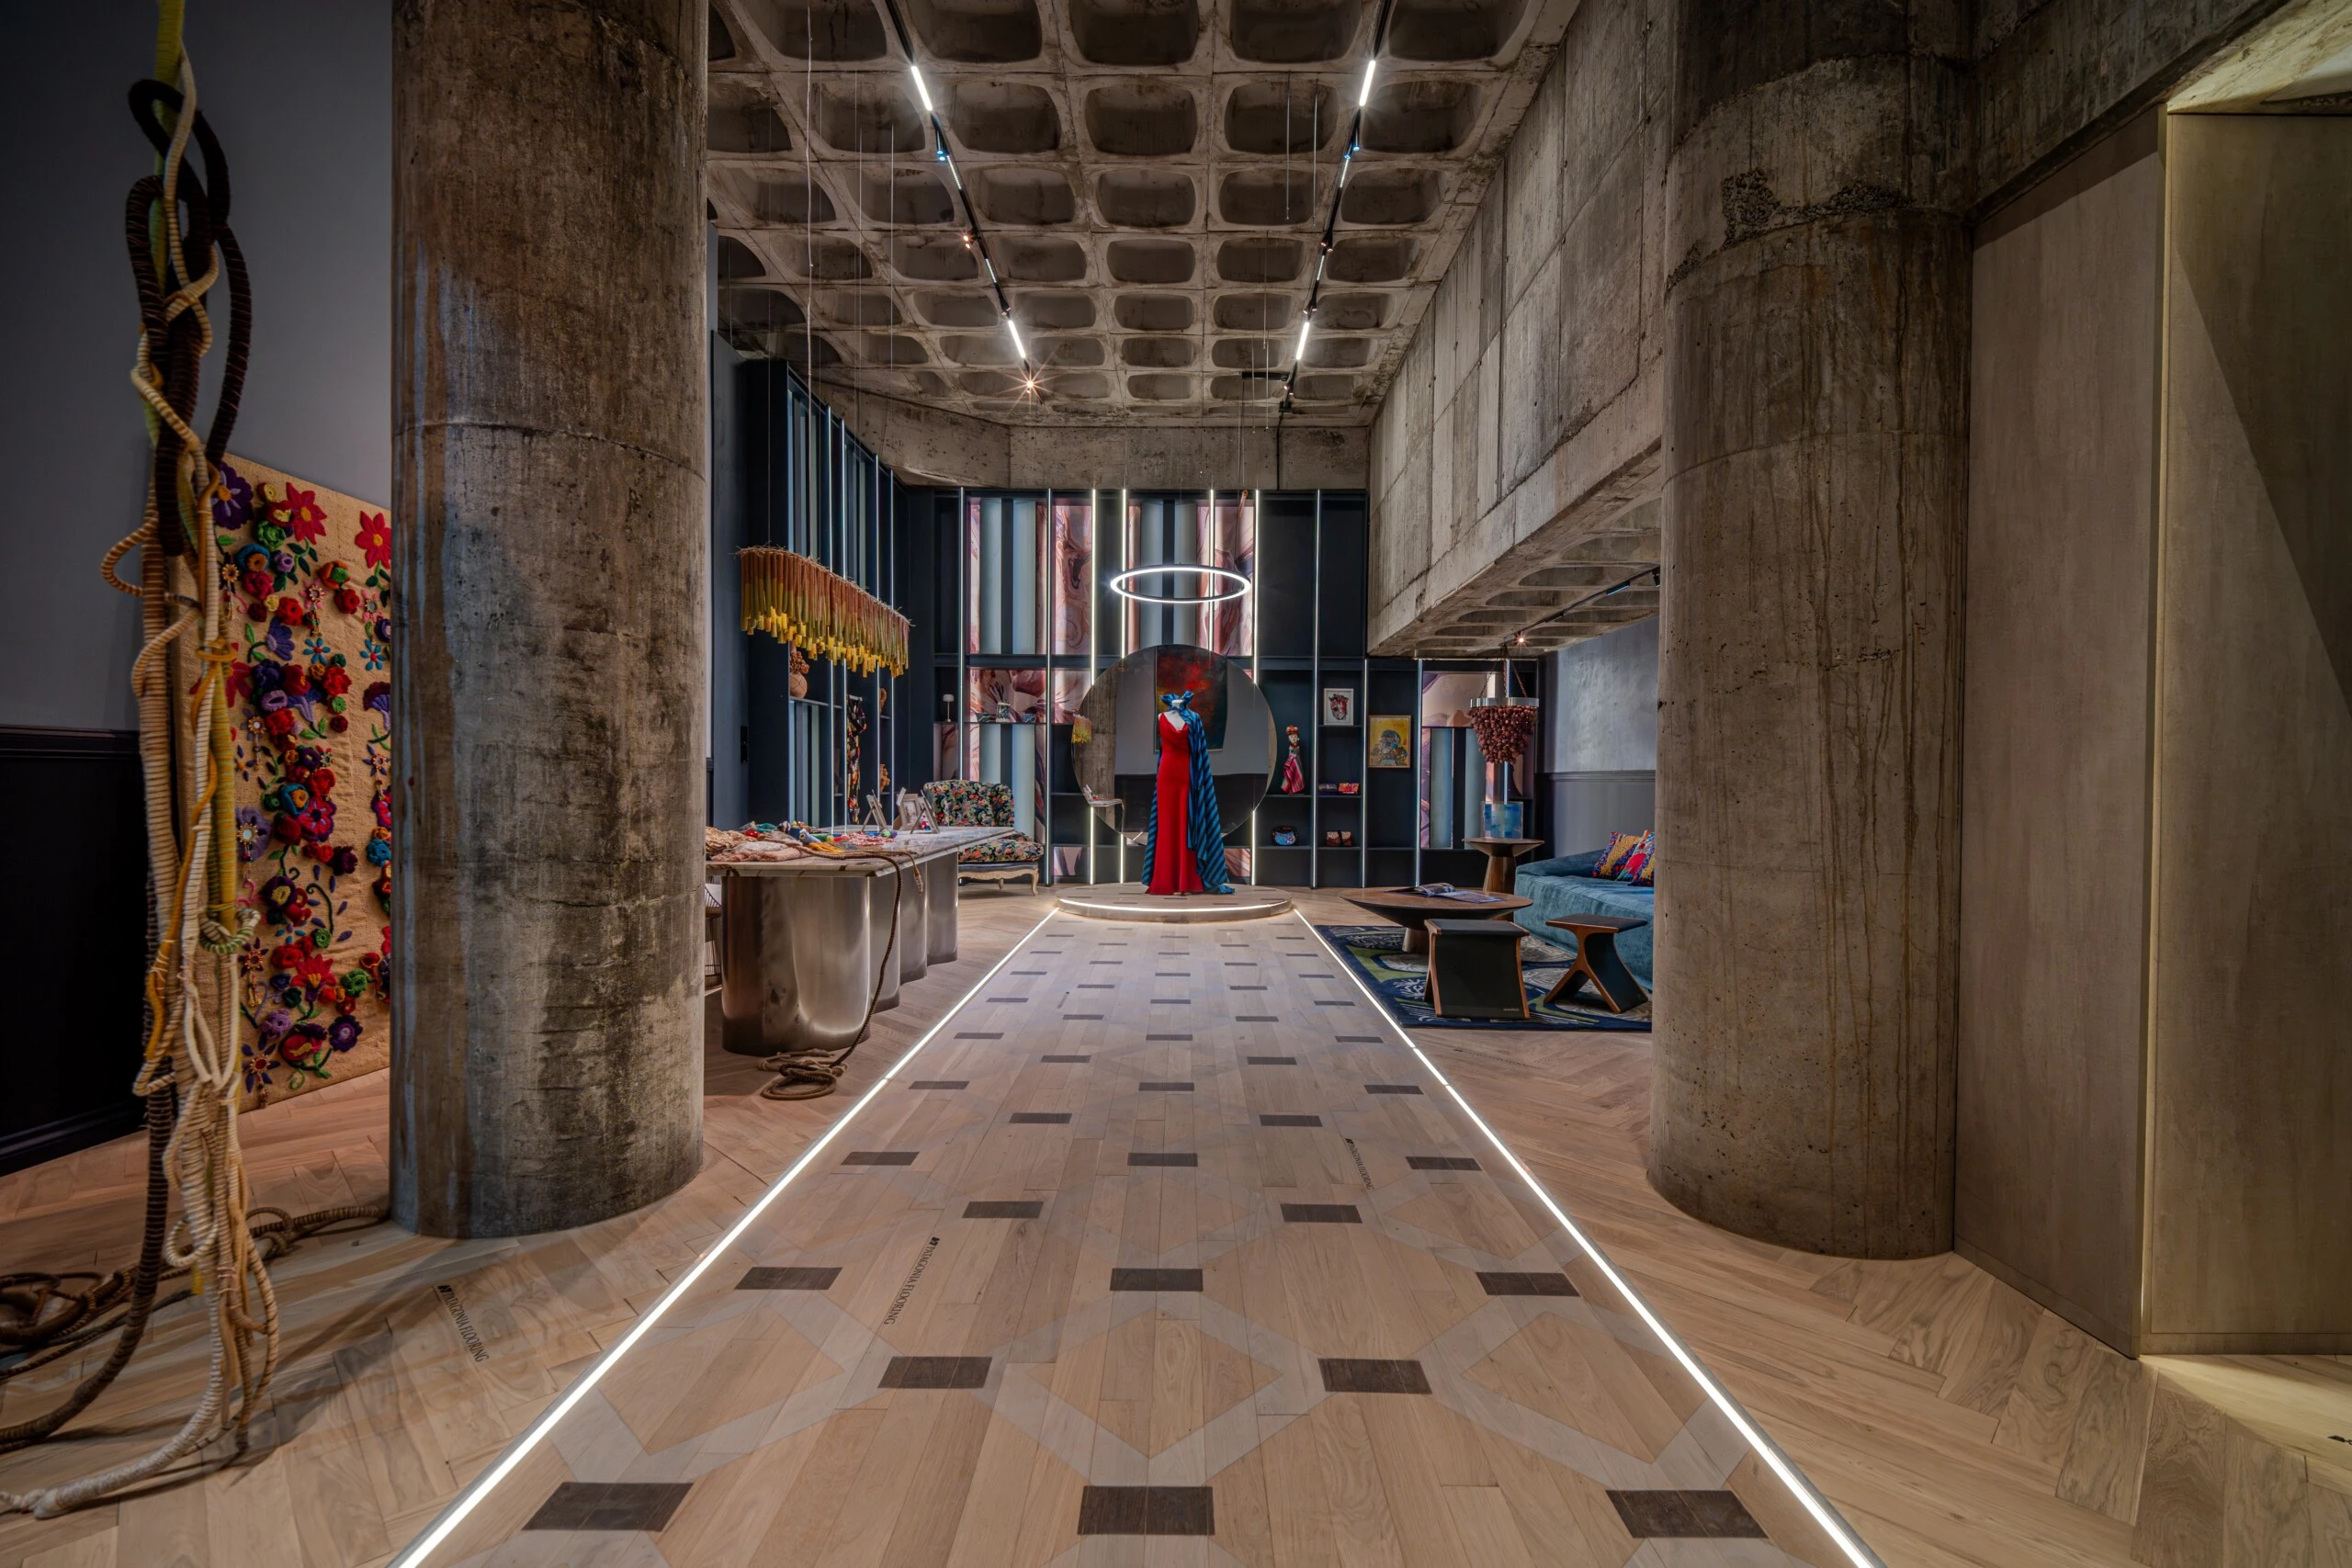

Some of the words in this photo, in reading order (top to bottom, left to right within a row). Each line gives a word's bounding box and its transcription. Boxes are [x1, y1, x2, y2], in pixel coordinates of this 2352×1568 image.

[907, 1245, 936, 1283] PATAGONIA
[883, 1283, 915, 1325] FLOORING
[441, 1292, 469, 1328] PATAGONIA
[458, 1325, 491, 1362] FLOORING
